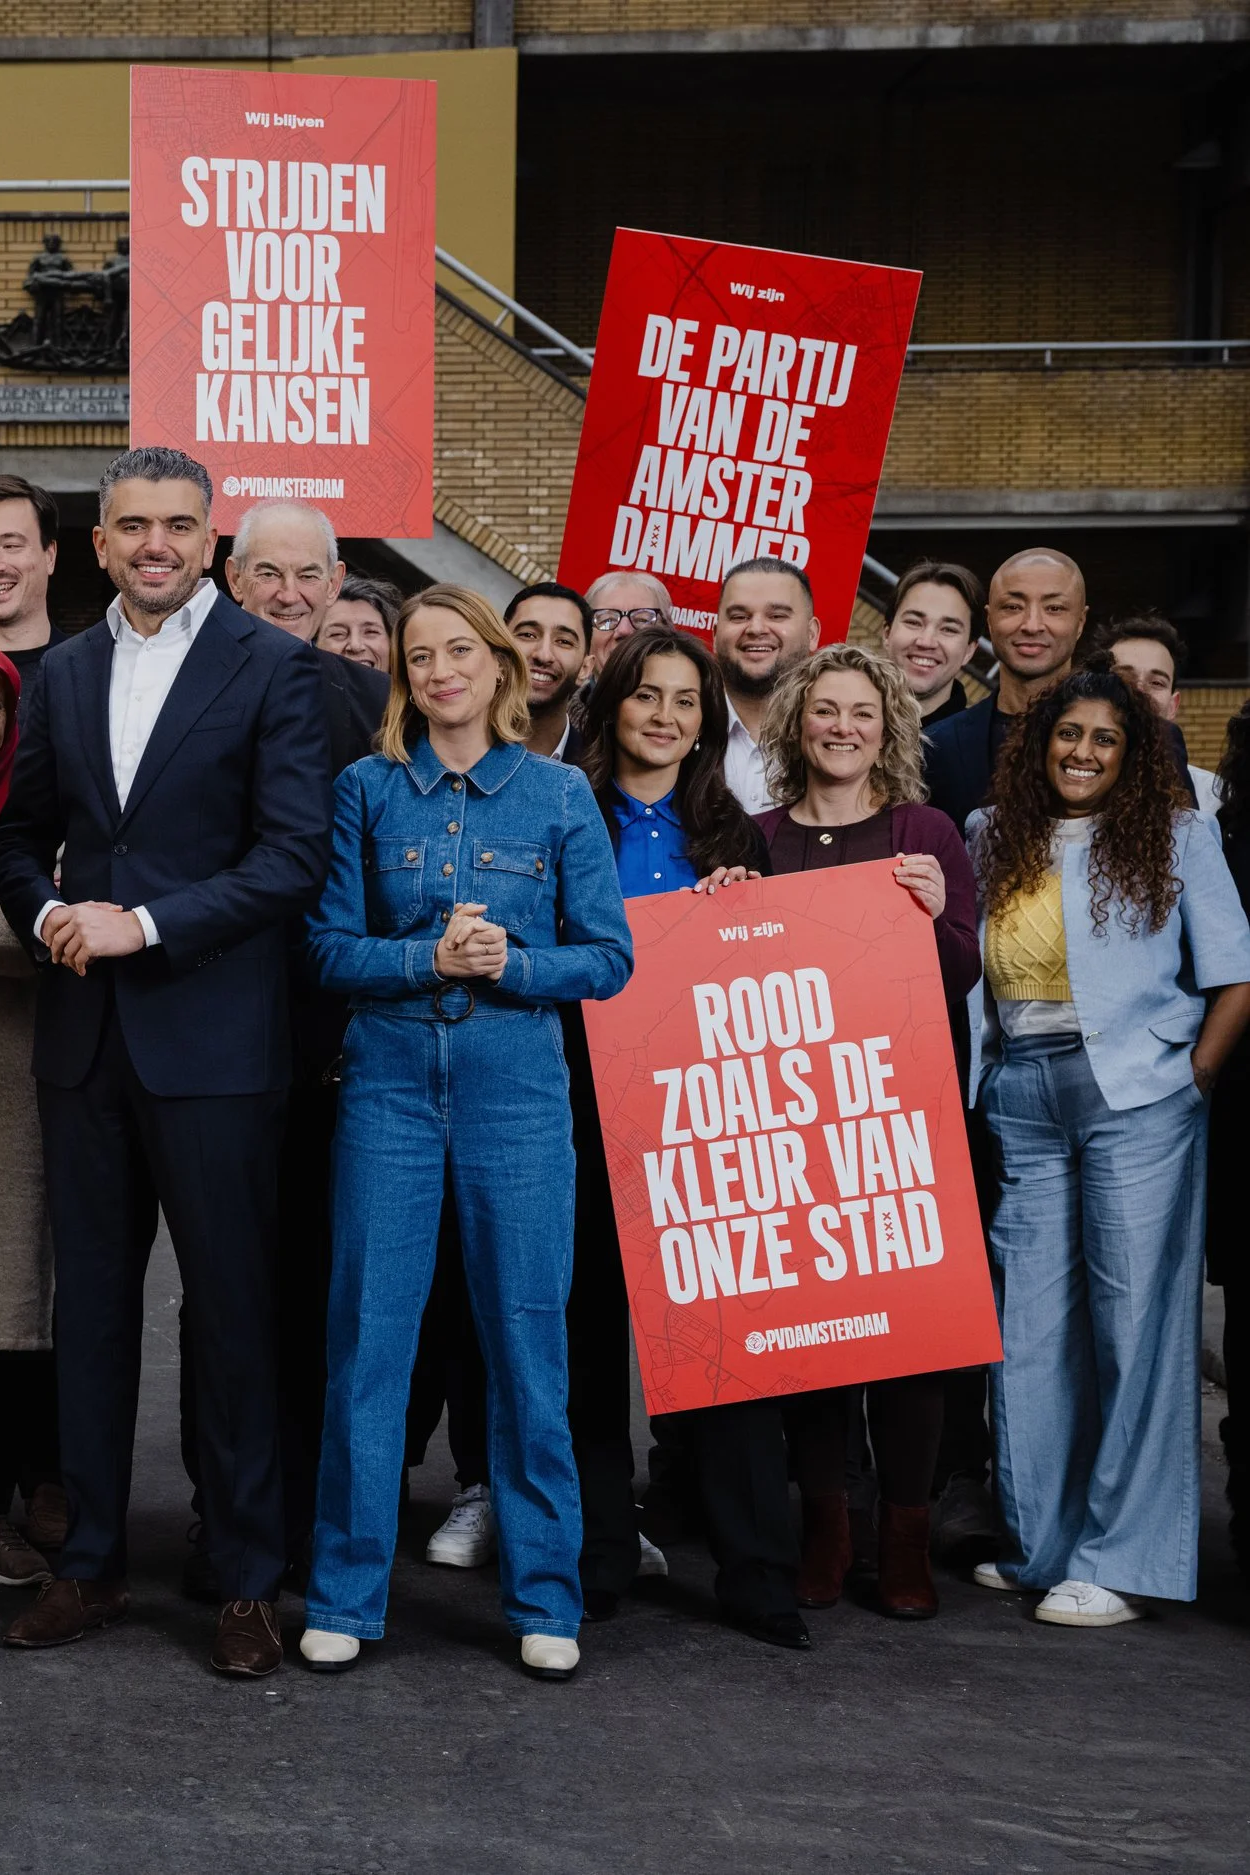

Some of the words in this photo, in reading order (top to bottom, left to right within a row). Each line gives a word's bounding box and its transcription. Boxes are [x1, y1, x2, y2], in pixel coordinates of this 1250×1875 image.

[244, 112, 270, 128] Wij
[273, 113, 324, 130] blijven
[181, 156, 385, 233] STRIJDEN
[225, 231, 342, 304] VOOR
[730, 282, 754, 298] Wij
[757, 289, 784, 302] zijn
[201, 301, 365, 374] GELIJKE
[638, 314, 699, 383] DE
[705, 325, 857, 406] PARTIJ
[196, 373, 370, 445] KANSEN
[658, 383, 746, 456] VAN
[753, 399, 816, 467] DE
[629, 445, 812, 533] AMSTER
[718, 924, 749, 942] Wij
[753, 921, 785, 939] zijn
[692, 966, 835, 1059] ROOD
[653, 1048, 818, 1146] ZOALS
[828, 1035, 901, 1118] DE
[643, 1131, 816, 1227] KLEUR
[822, 1110, 935, 1198] VAN
[660, 1211, 799, 1304] ONZE
[808, 1190, 944, 1281] STAD
